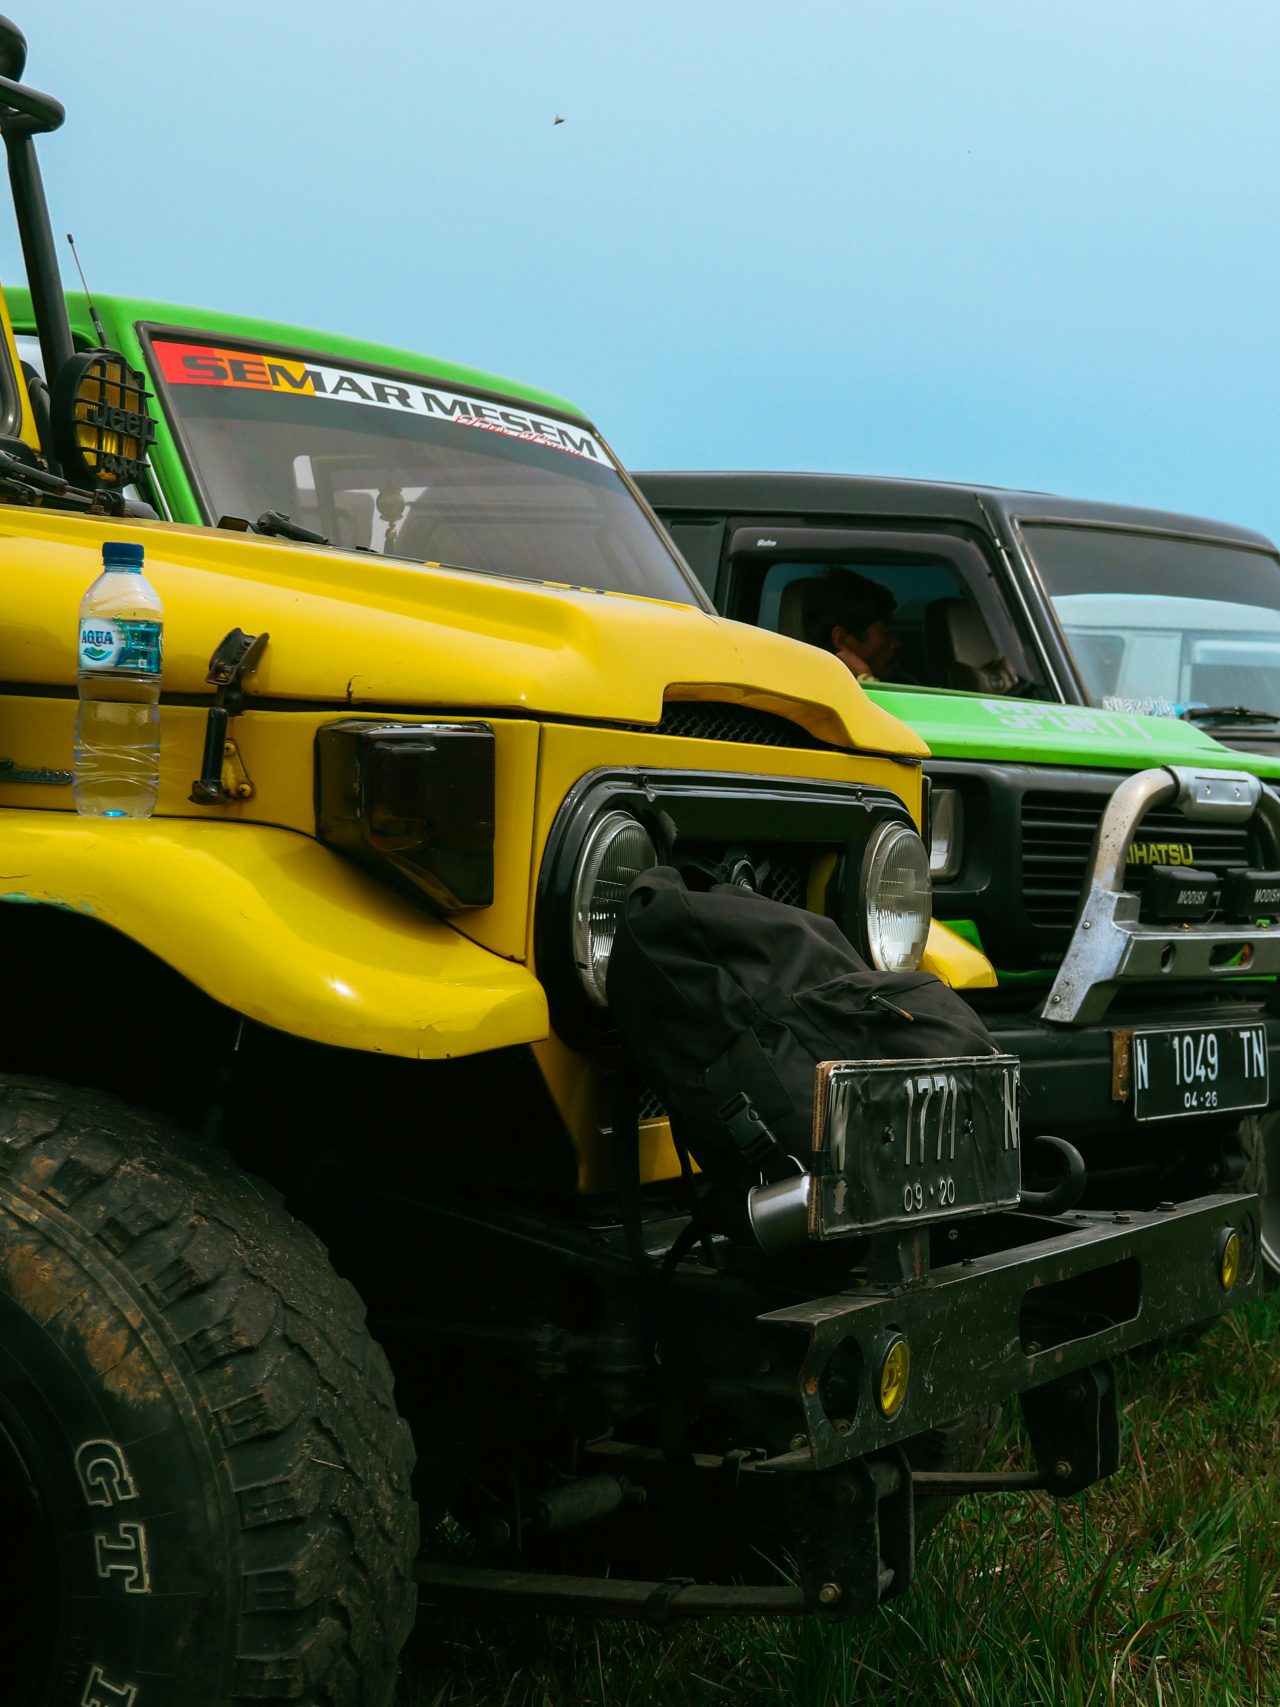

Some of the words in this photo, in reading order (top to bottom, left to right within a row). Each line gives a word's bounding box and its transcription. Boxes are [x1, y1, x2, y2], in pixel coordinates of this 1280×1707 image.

[88, 400, 156, 443] Jeep
[182, 354, 416, 410] SEMAR
[420, 391, 598, 459] MESEM
[81, 630, 114, 647] AQUA
[1126, 843, 1194, 866] IHATSU
[1177, 890, 1208, 905] MODISH
[1136, 1039, 1149, 1090] N
[1173, 1033, 1219, 1086] 1049
[1239, 1030, 1265, 1078] TN
[75, 1439, 152, 1594] GT
